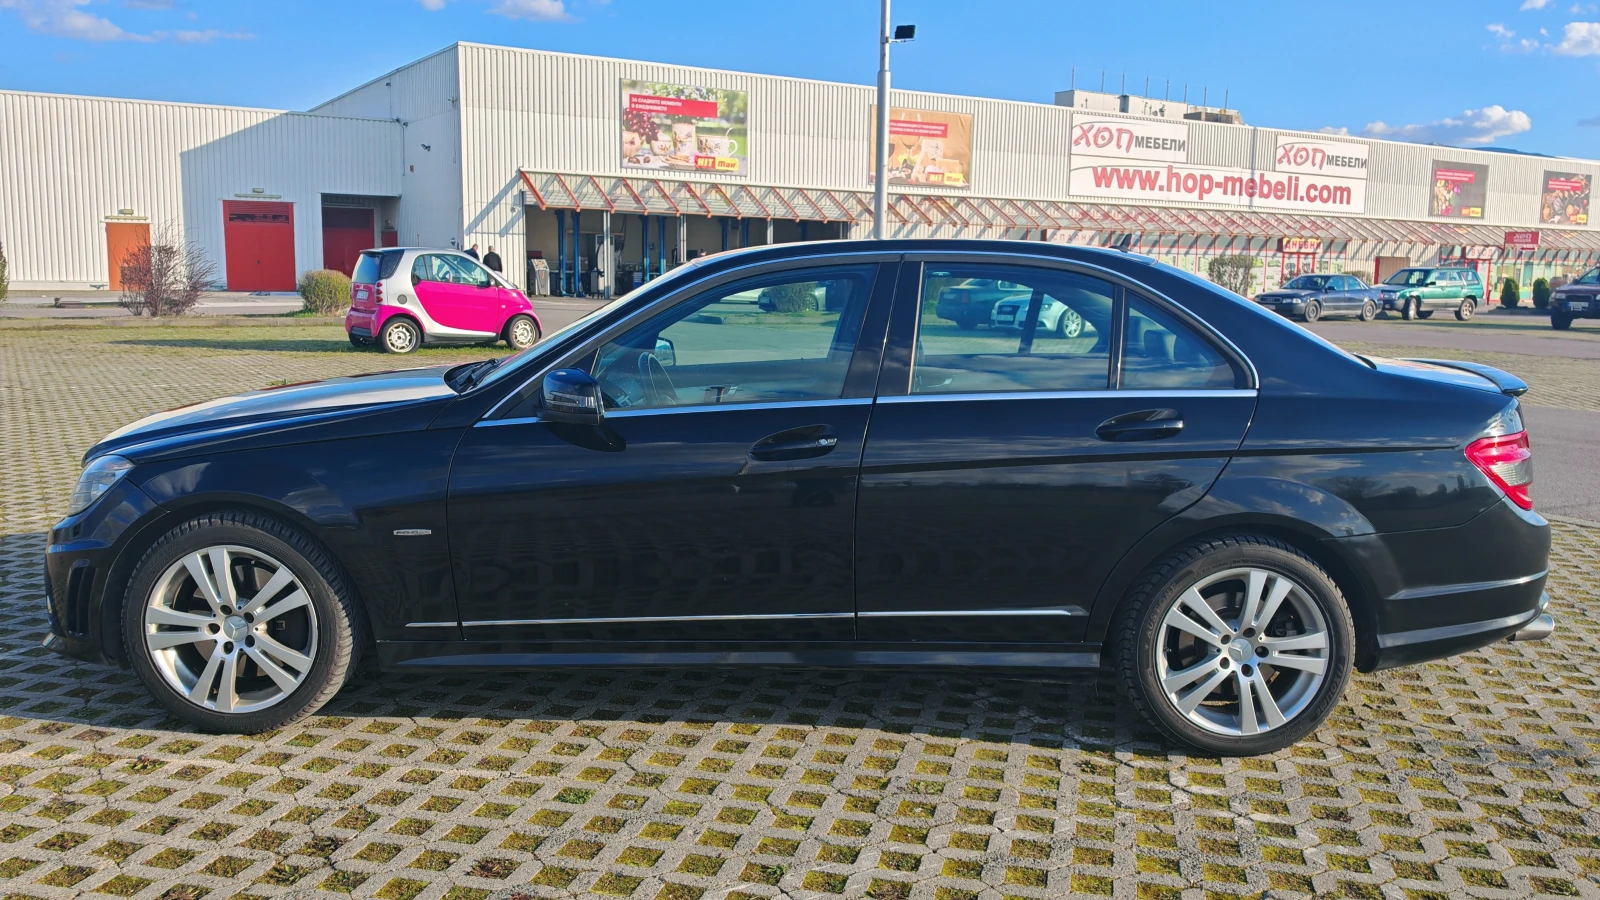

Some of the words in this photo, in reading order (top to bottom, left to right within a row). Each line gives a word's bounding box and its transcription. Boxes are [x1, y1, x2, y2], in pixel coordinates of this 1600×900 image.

[1073, 124, 1134, 153] ХОП
[1134, 135, 1186, 152] МЕБЕЛИ
[697, 157, 715, 167] HIT
[1277, 144, 1326, 171] ХОП
[1326, 154, 1368, 169] МЕБЕЛИ
[1092, 165, 1351, 205] www.hop-mebeli.com
